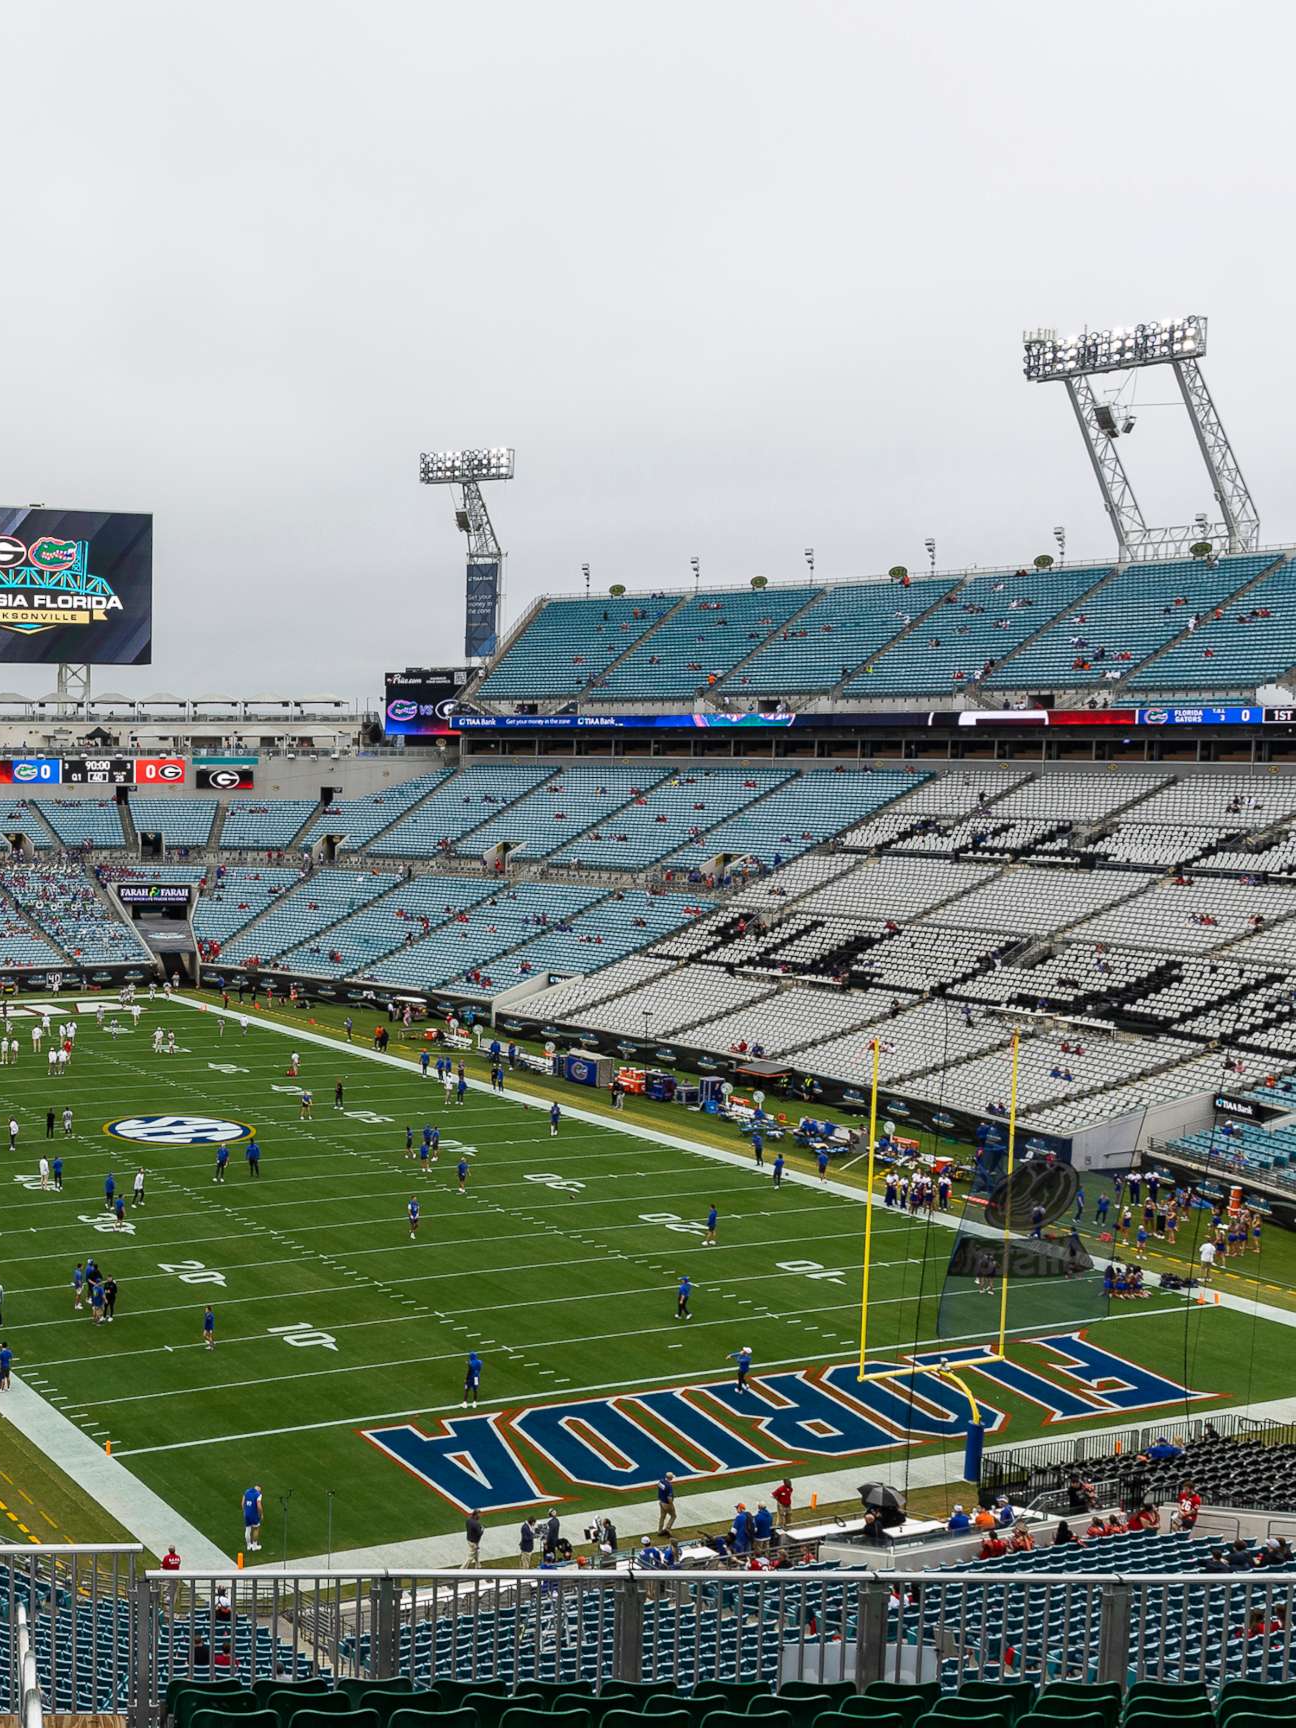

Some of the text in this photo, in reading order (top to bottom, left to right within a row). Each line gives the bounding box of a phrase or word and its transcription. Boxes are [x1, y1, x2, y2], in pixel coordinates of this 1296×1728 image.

[34, 595, 123, 610] FLORIDA
[419, 704, 433, 715] VS
[1241, 709, 1250, 721] 0
[1274, 710, 1293, 720] 1ST
[600, 717, 615, 725] Bank
[85, 760, 110, 770] 90:00
[41, 765, 50, 779] 0
[71, 773, 81, 781] Q1
[145, 765, 155, 779] 0
[120, 888, 149, 896] FARAH
[160, 888, 189, 896] FARAH
[47, 973, 61, 984] 40
[157, 1259, 227, 1286] 20
[266, 1321, 338, 1349] 10
[357, 1330, 1234, 1514] FLORIDA
